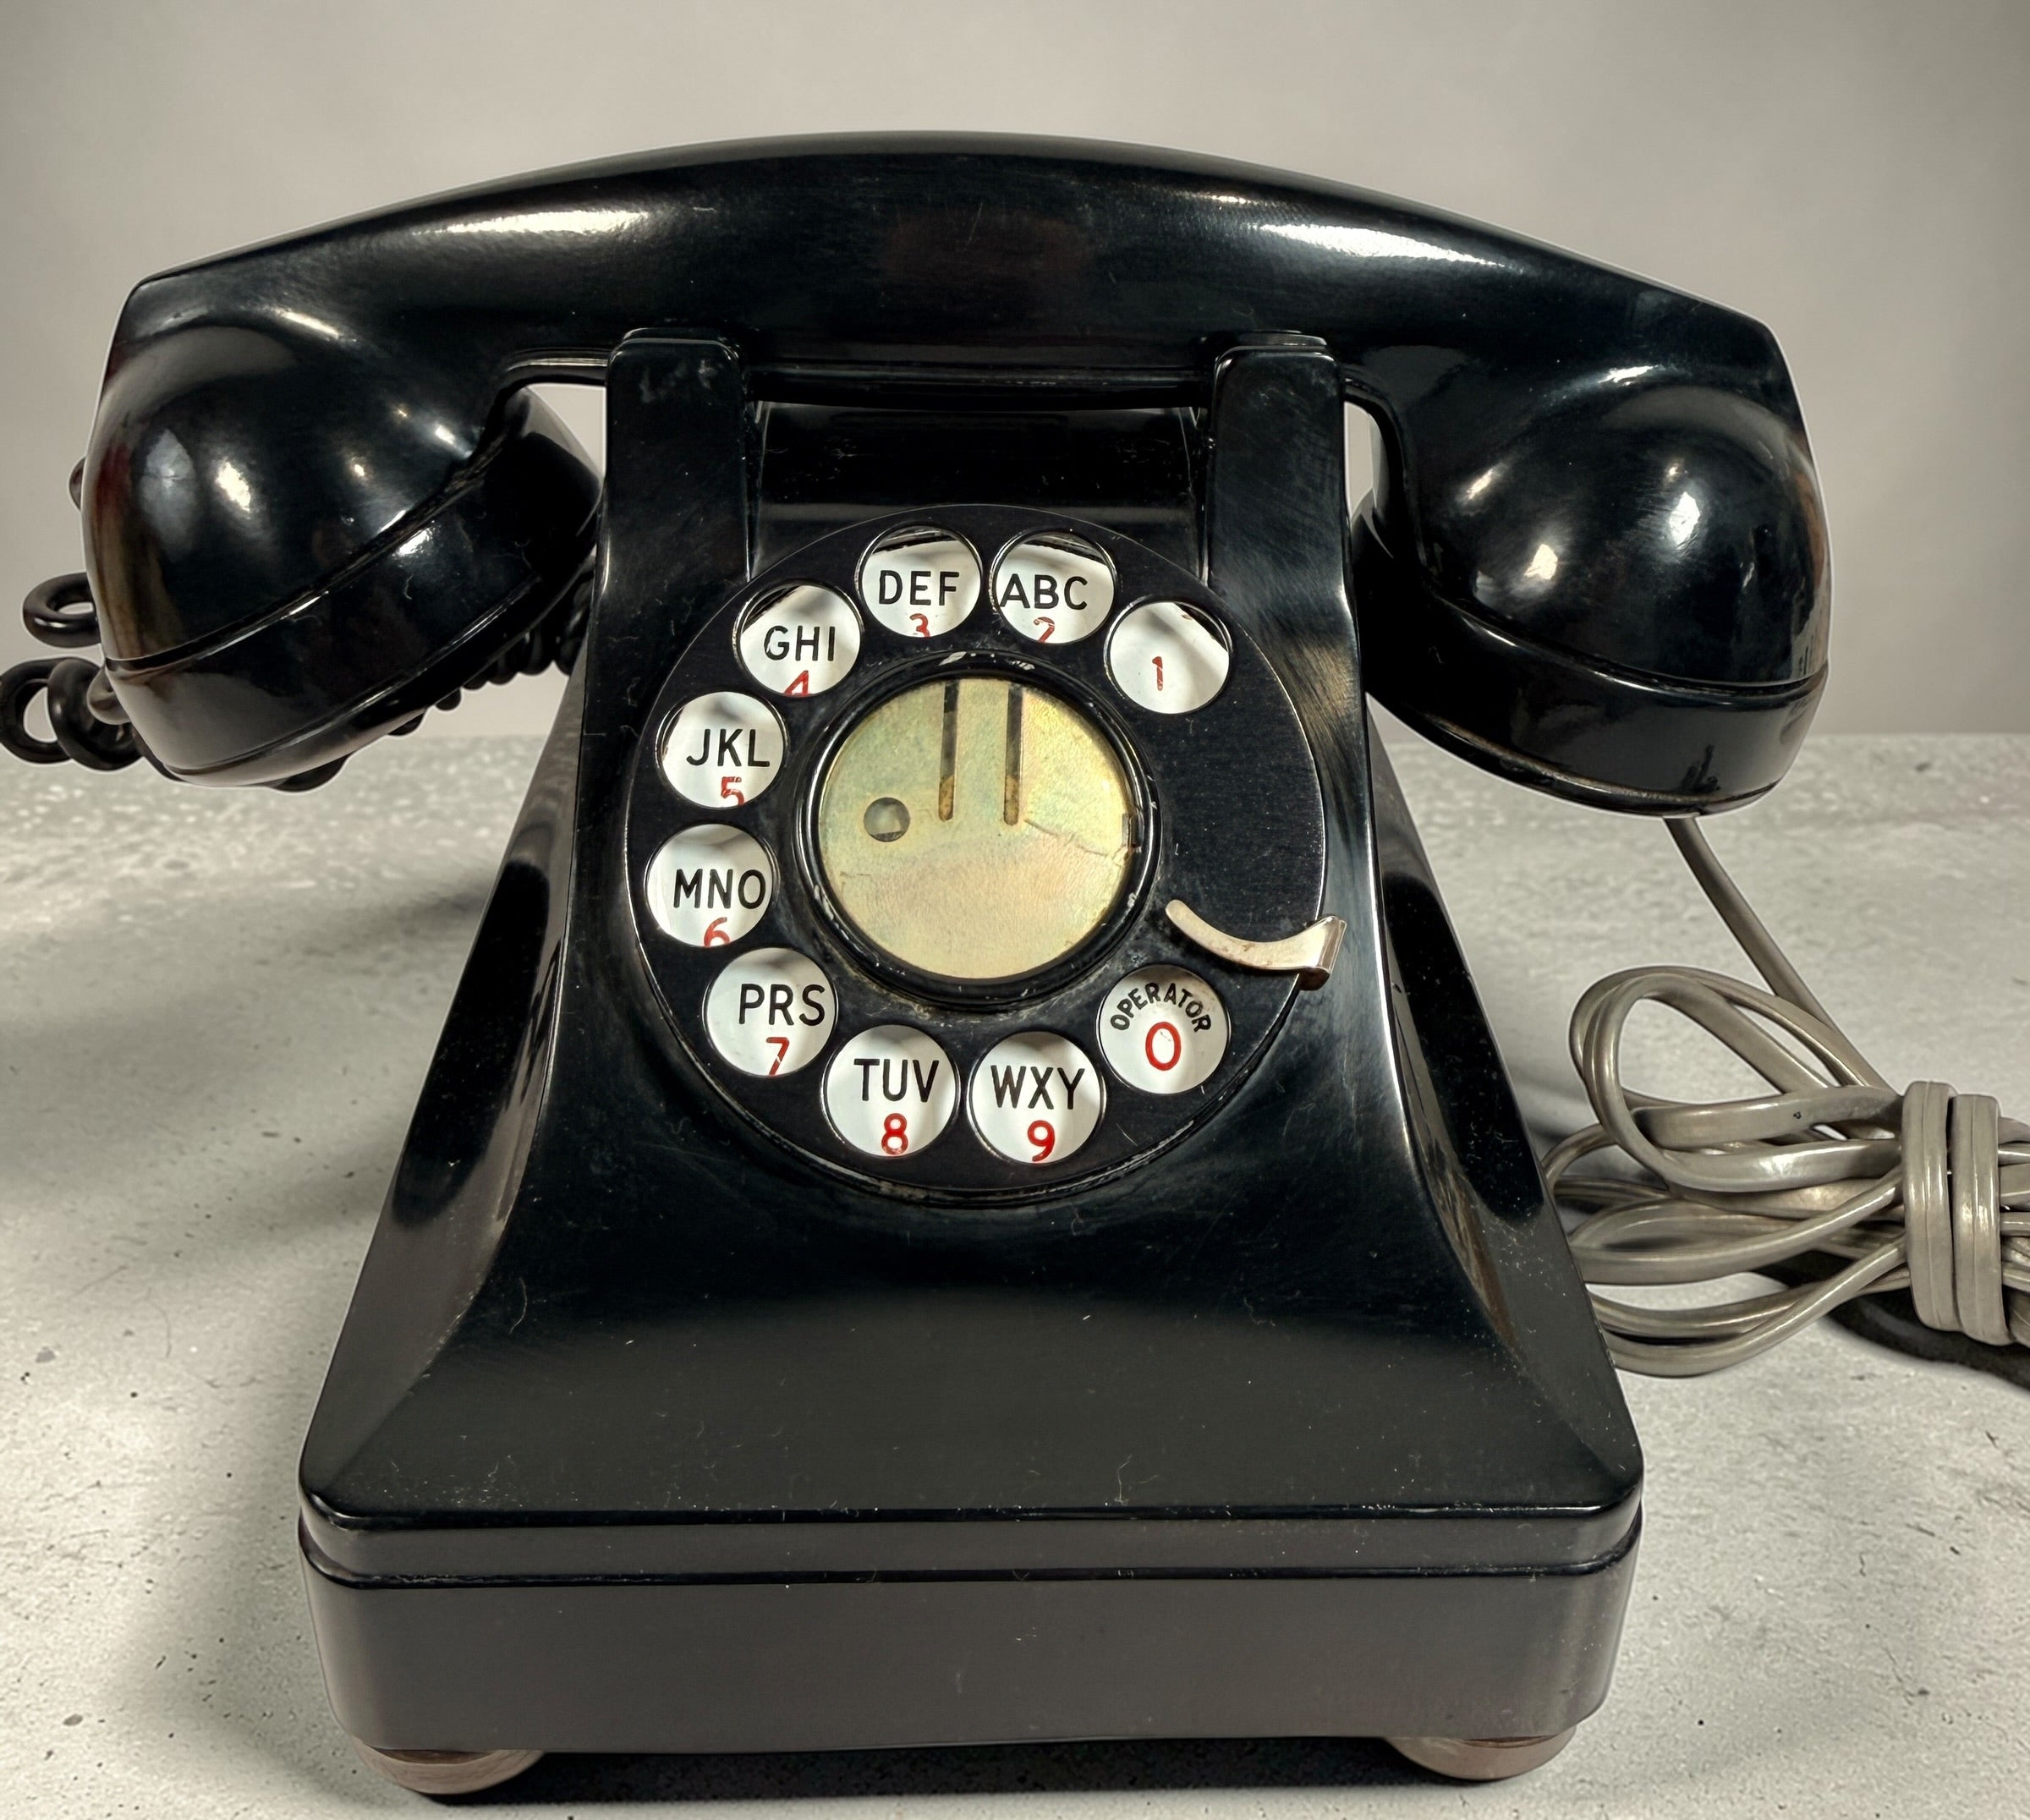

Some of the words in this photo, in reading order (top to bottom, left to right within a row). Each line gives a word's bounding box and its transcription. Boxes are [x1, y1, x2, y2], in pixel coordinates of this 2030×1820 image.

[878, 570, 960, 606] DEF
[1000, 573, 1088, 610] ABC
[764, 625, 836, 661] GHI
[908, 613, 930, 638] 3
[1034, 617, 1056, 644] 2
[783, 670, 811, 697] 4
[1152, 655, 1163, 691] 1
[686, 728, 771, 767] JKL
[721, 776, 745, 805] 5
[673, 869, 766, 909] MNO
[704, 917, 731, 947] 6
[738, 984, 826, 1026] PRS
[1111, 982, 1211, 1033] OPERATOR
[765, 1037, 790, 1075] 7
[1145, 1022, 1182, 1071] 0
[853, 1058, 940, 1103] TUV
[990, 1065, 1085, 1110] WXY
[881, 1113, 909, 1155] 8
[1027, 1120, 1056, 1162] 9
